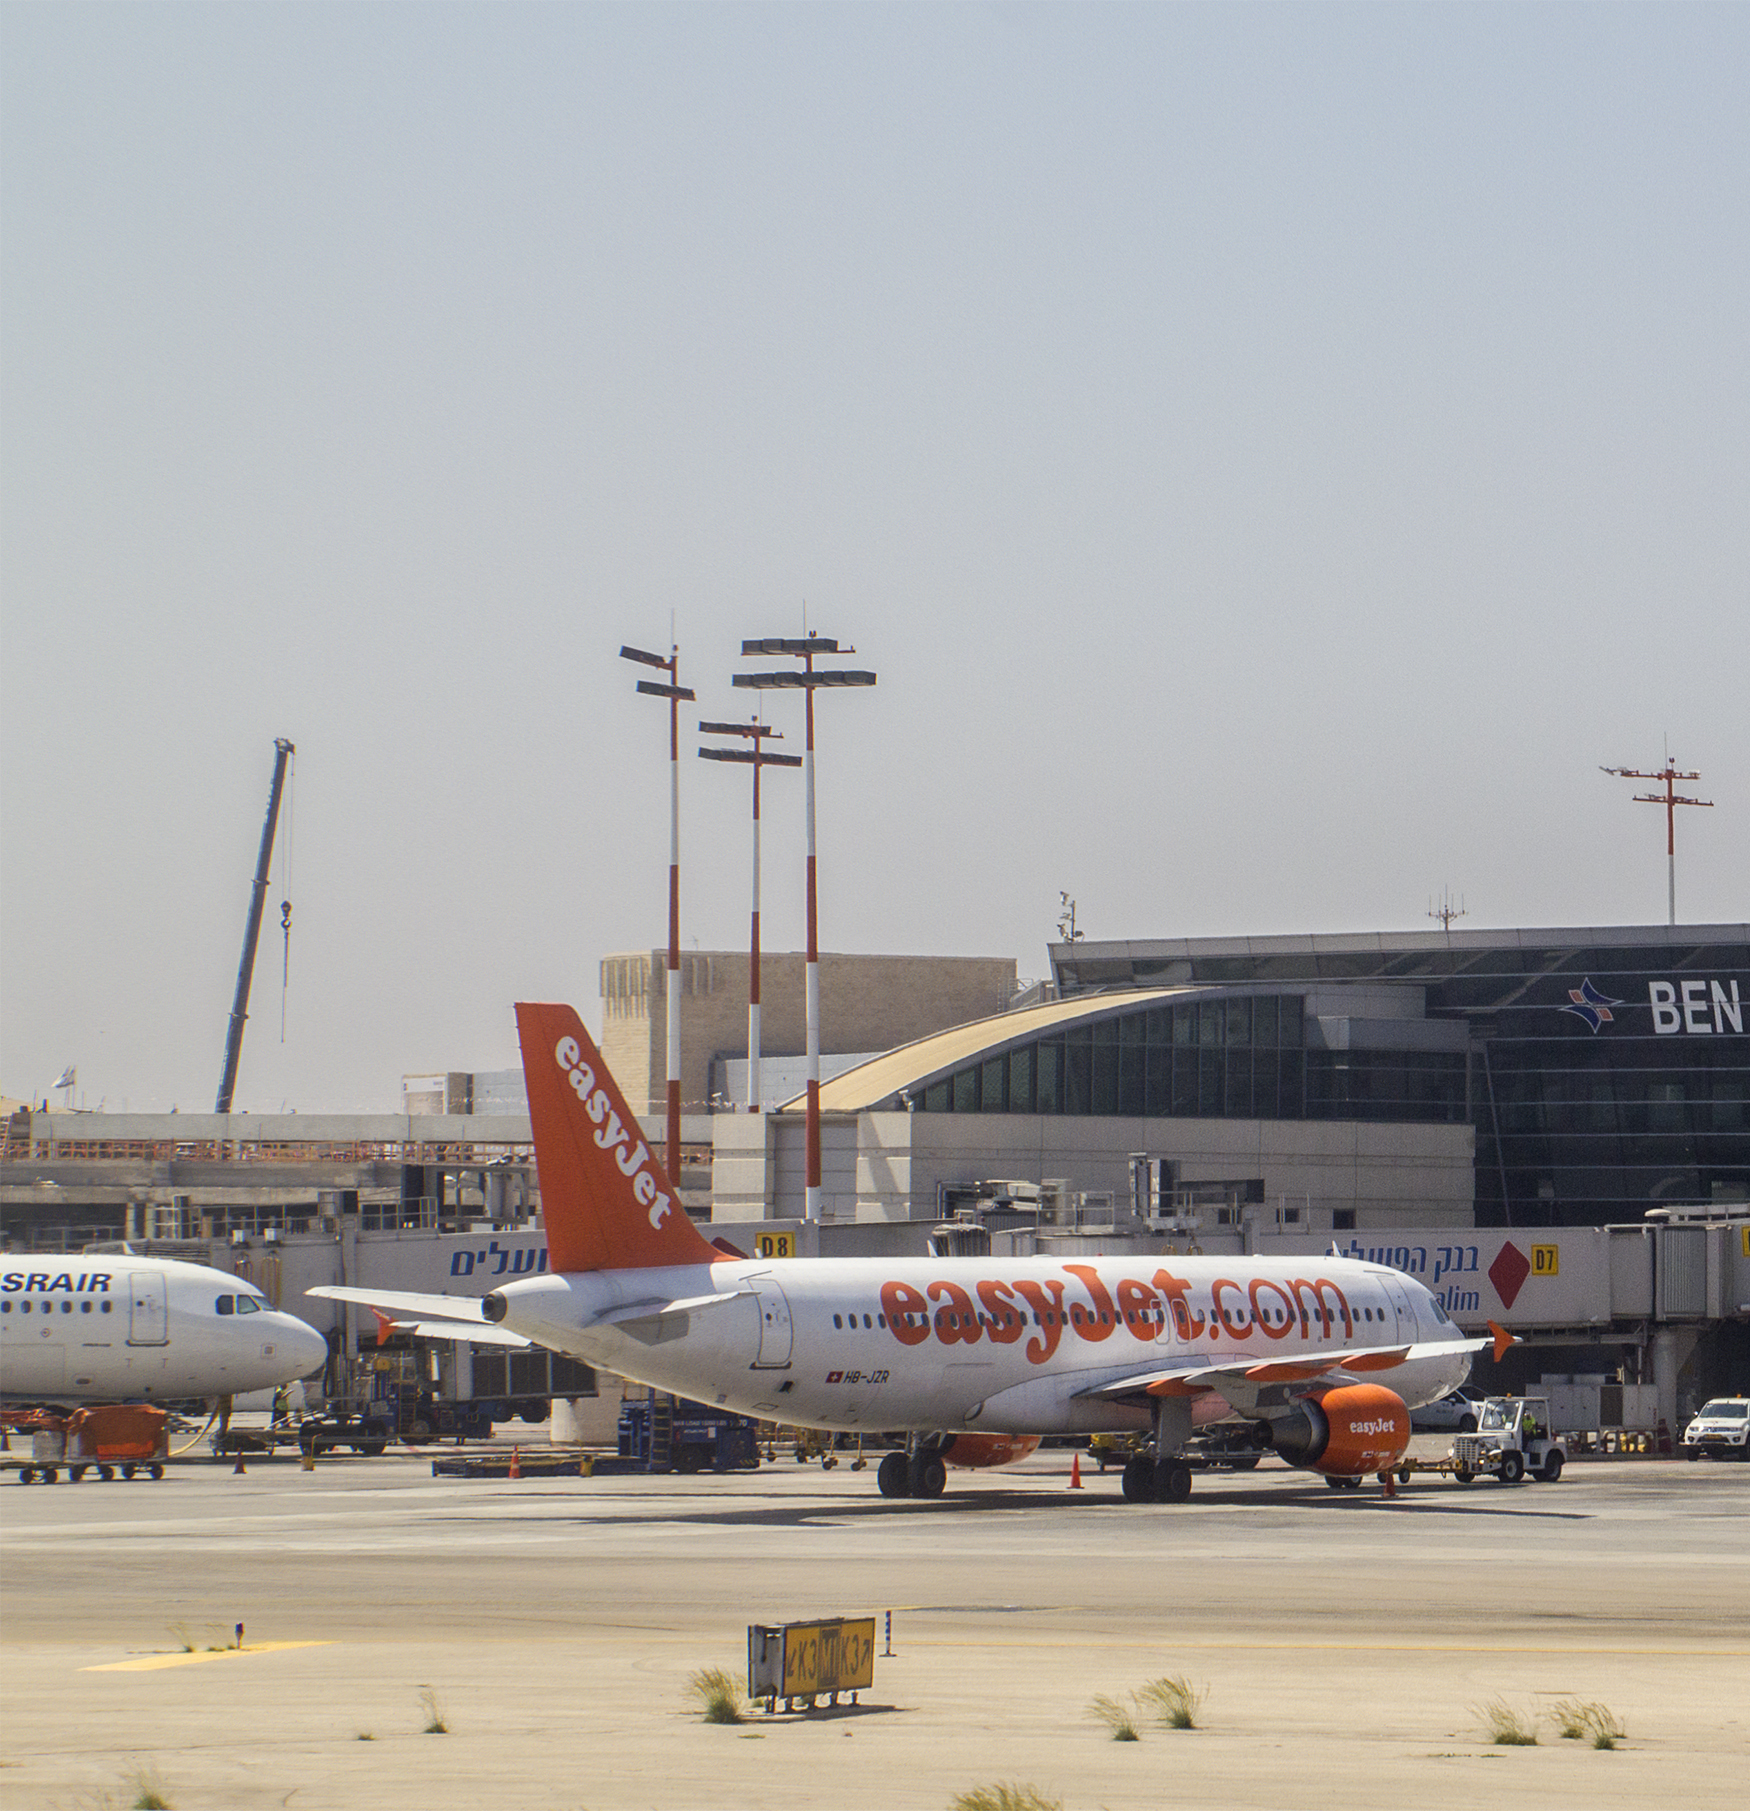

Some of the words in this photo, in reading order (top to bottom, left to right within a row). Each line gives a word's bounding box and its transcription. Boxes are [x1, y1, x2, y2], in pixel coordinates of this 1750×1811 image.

[1648, 979, 1743, 1034] BEN
[555, 1036, 671, 1230] easyJet
[1433, 1245, 1480, 1284] בנק
[1536, 1249, 1555, 1271] D7
[0, 1272, 113, 1293] SRAIR
[879, 1264, 1353, 1366] easyJet.com
[843, 1370, 890, 1384] HB-JZR
[1349, 1418, 1395, 1436] easyJet
[798, 1638, 817, 1681] K3
[840, 1634, 859, 1676] K3
